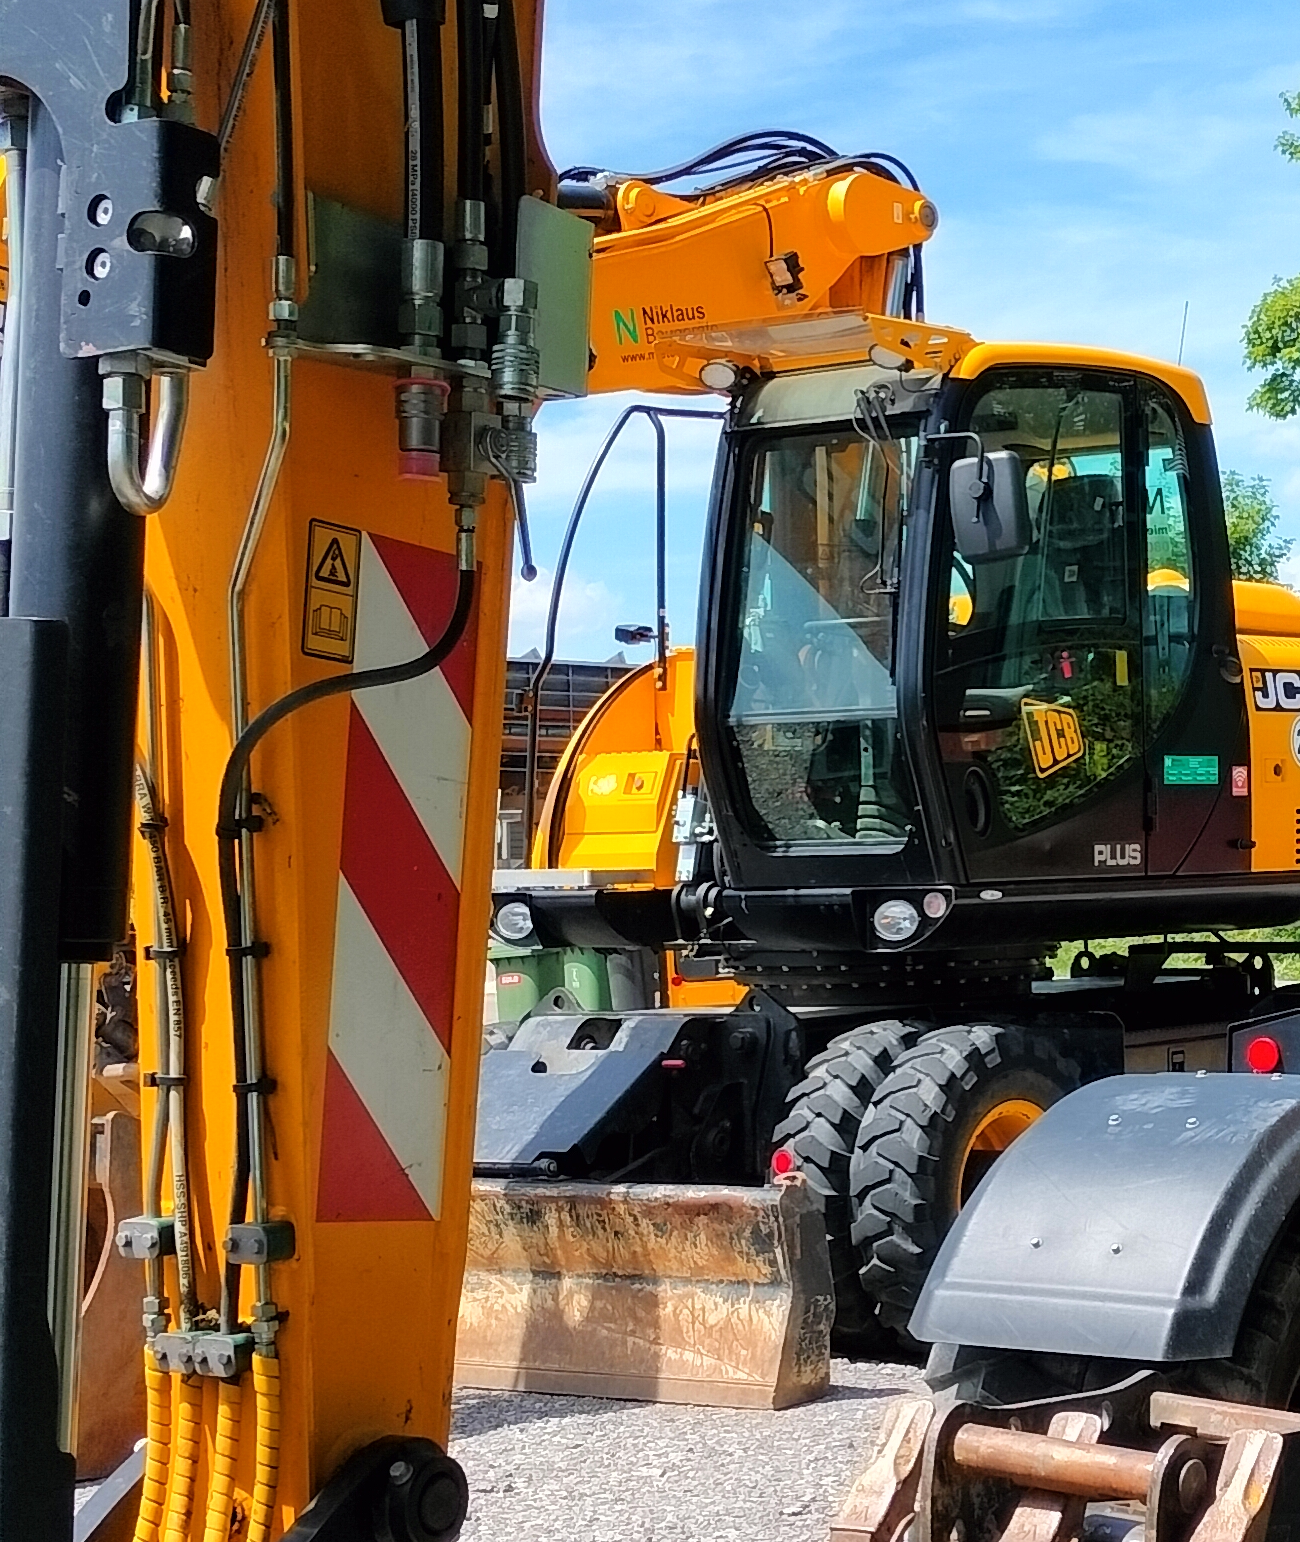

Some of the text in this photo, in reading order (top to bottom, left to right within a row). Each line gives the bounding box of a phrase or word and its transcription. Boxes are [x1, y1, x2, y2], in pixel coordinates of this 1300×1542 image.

[410, 164, 419, 186] MPa
[642, 304, 706, 326] Niklaus
[613, 308, 639, 345] N
[1032, 709, 1081, 770] JCB
[1094, 844, 1141, 865] PLUS
[171, 999, 181, 1016] EN
[173, 1019, 182, 1039] 857
[175, 1173, 188, 1230] HSS-SHP
